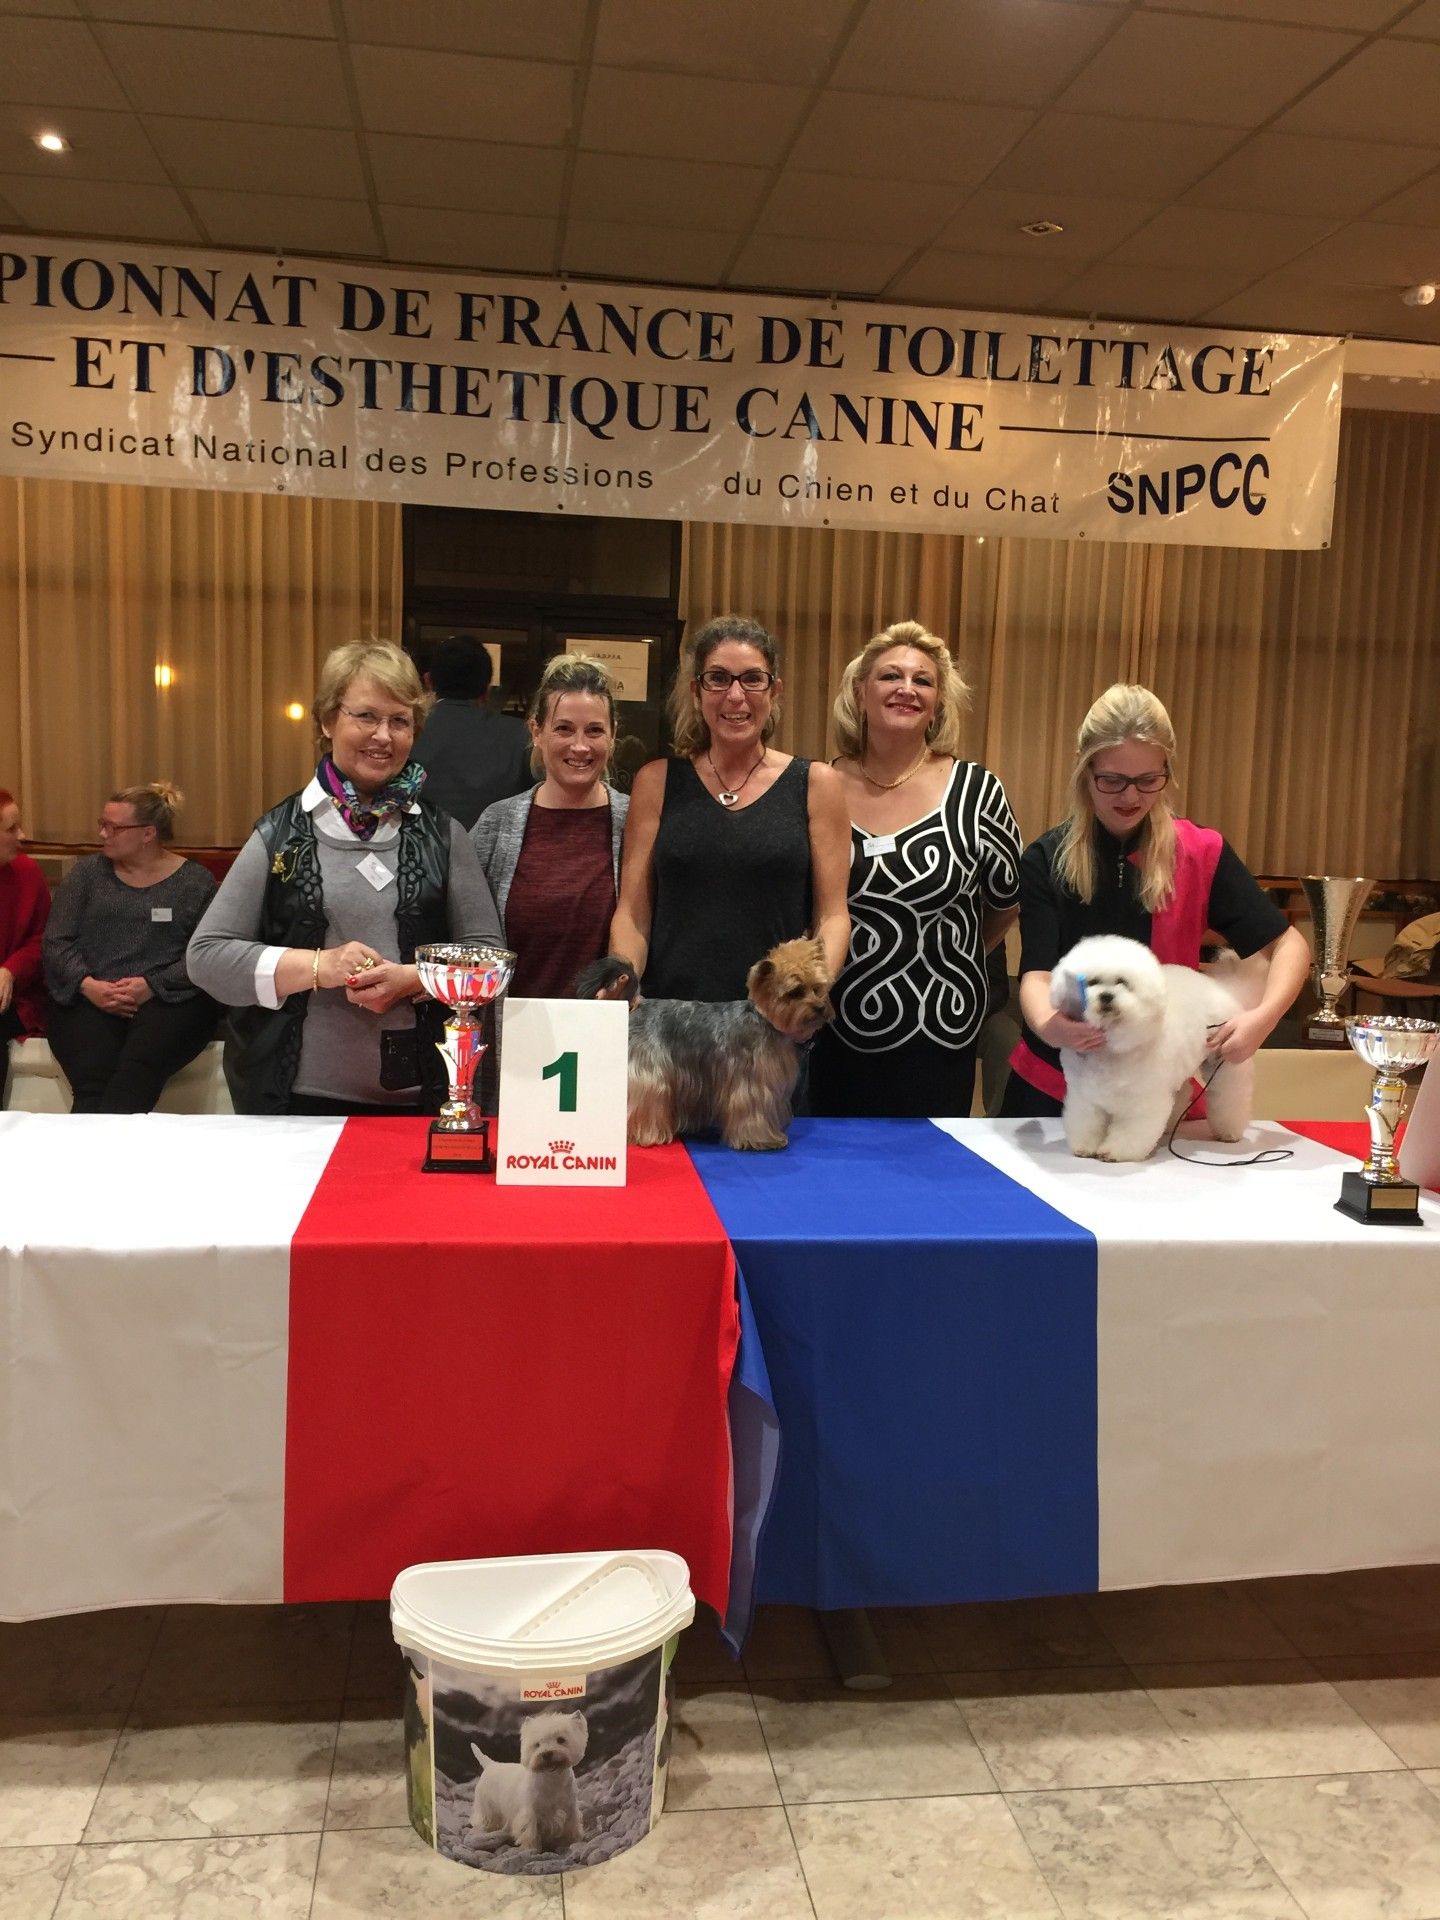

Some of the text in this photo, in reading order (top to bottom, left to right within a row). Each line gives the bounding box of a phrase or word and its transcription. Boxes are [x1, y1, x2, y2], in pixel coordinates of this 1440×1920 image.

[0, 253, 1275, 396] PIONNAT DE FRANCE DE TOILETTAGE
[70, 336, 985, 452] ET D'ESTHETIQUE CANINE
[11, 421, 1060, 514] Syndicat National des Professions du Chien et du Chat
[1106, 452, 1271, 516] SNPCC
[542, 1051, 579, 1113] 1
[506, 1154, 617, 1171] ROYAL CANIN
[523, 1685, 583, 1699] ROYAL CANIN
